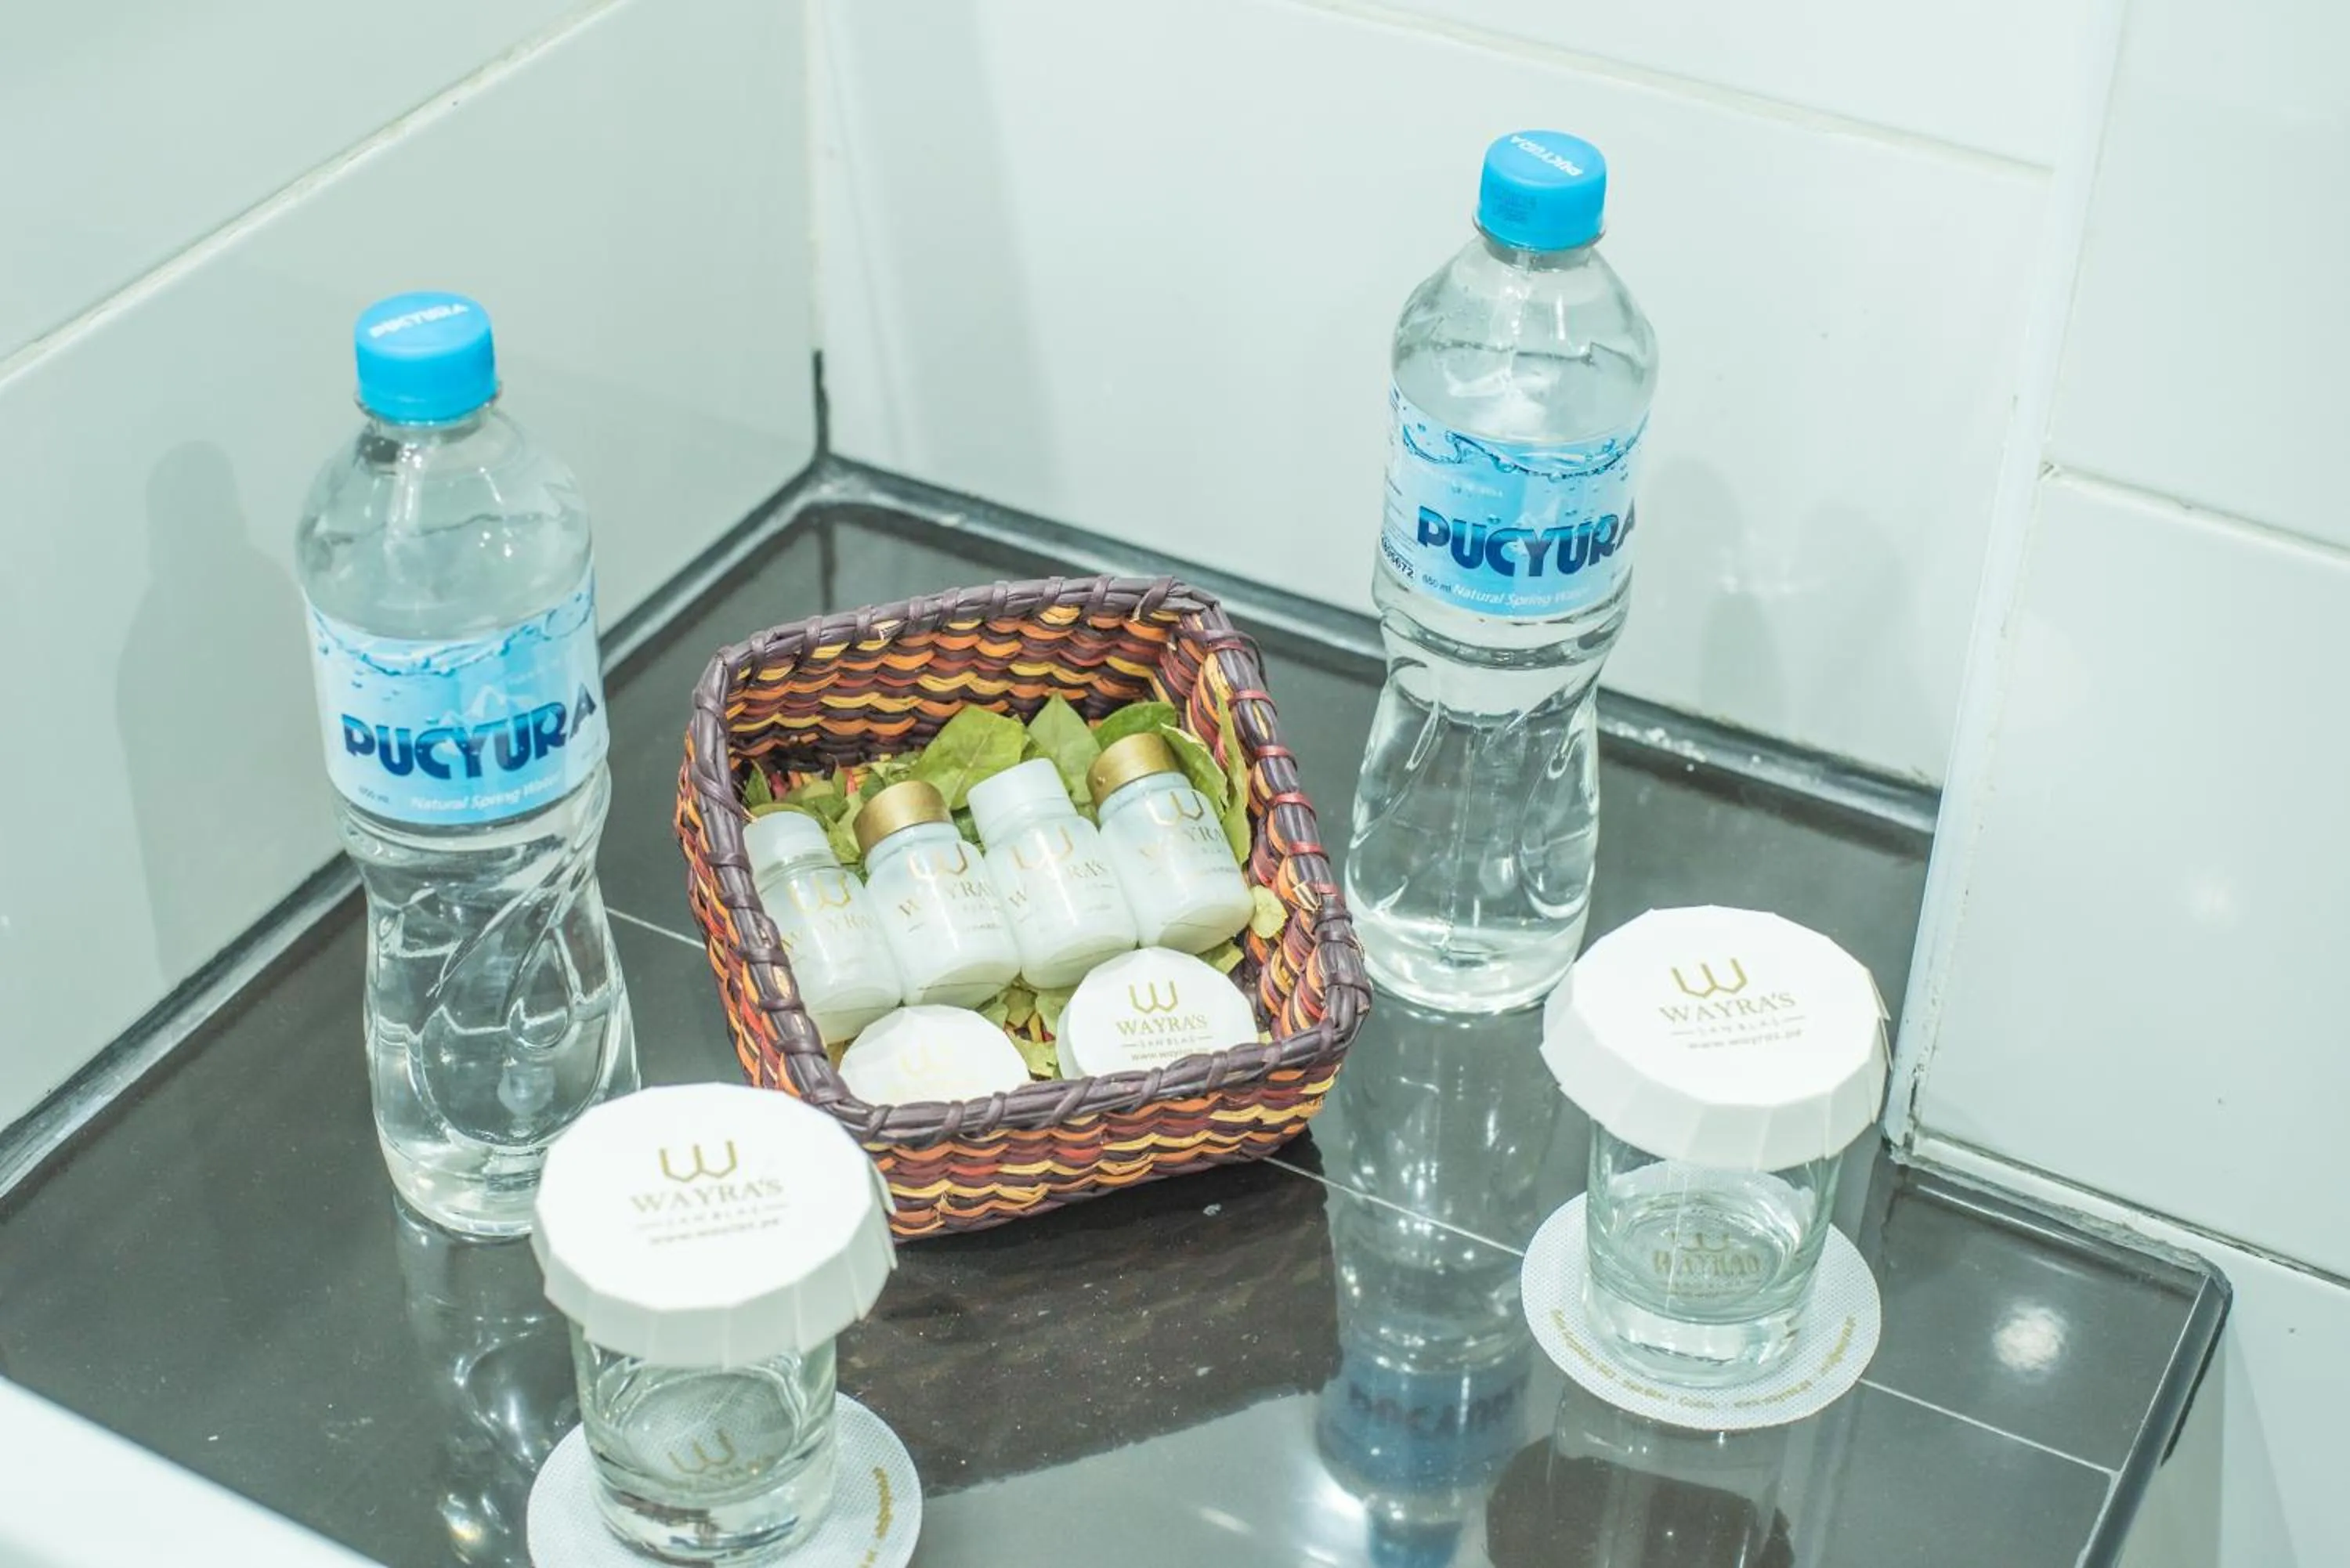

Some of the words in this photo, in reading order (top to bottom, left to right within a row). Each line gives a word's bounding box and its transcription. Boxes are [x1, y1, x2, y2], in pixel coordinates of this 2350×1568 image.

[1452, 583, 1506, 605] Natural
[342, 682, 598, 780] PUCYURA
[1658, 992, 1796, 1023] WAYRA'S
[1115, 1014, 1208, 1036] WAYRA'S
[629, 1177, 783, 1213] WAYRA'S
